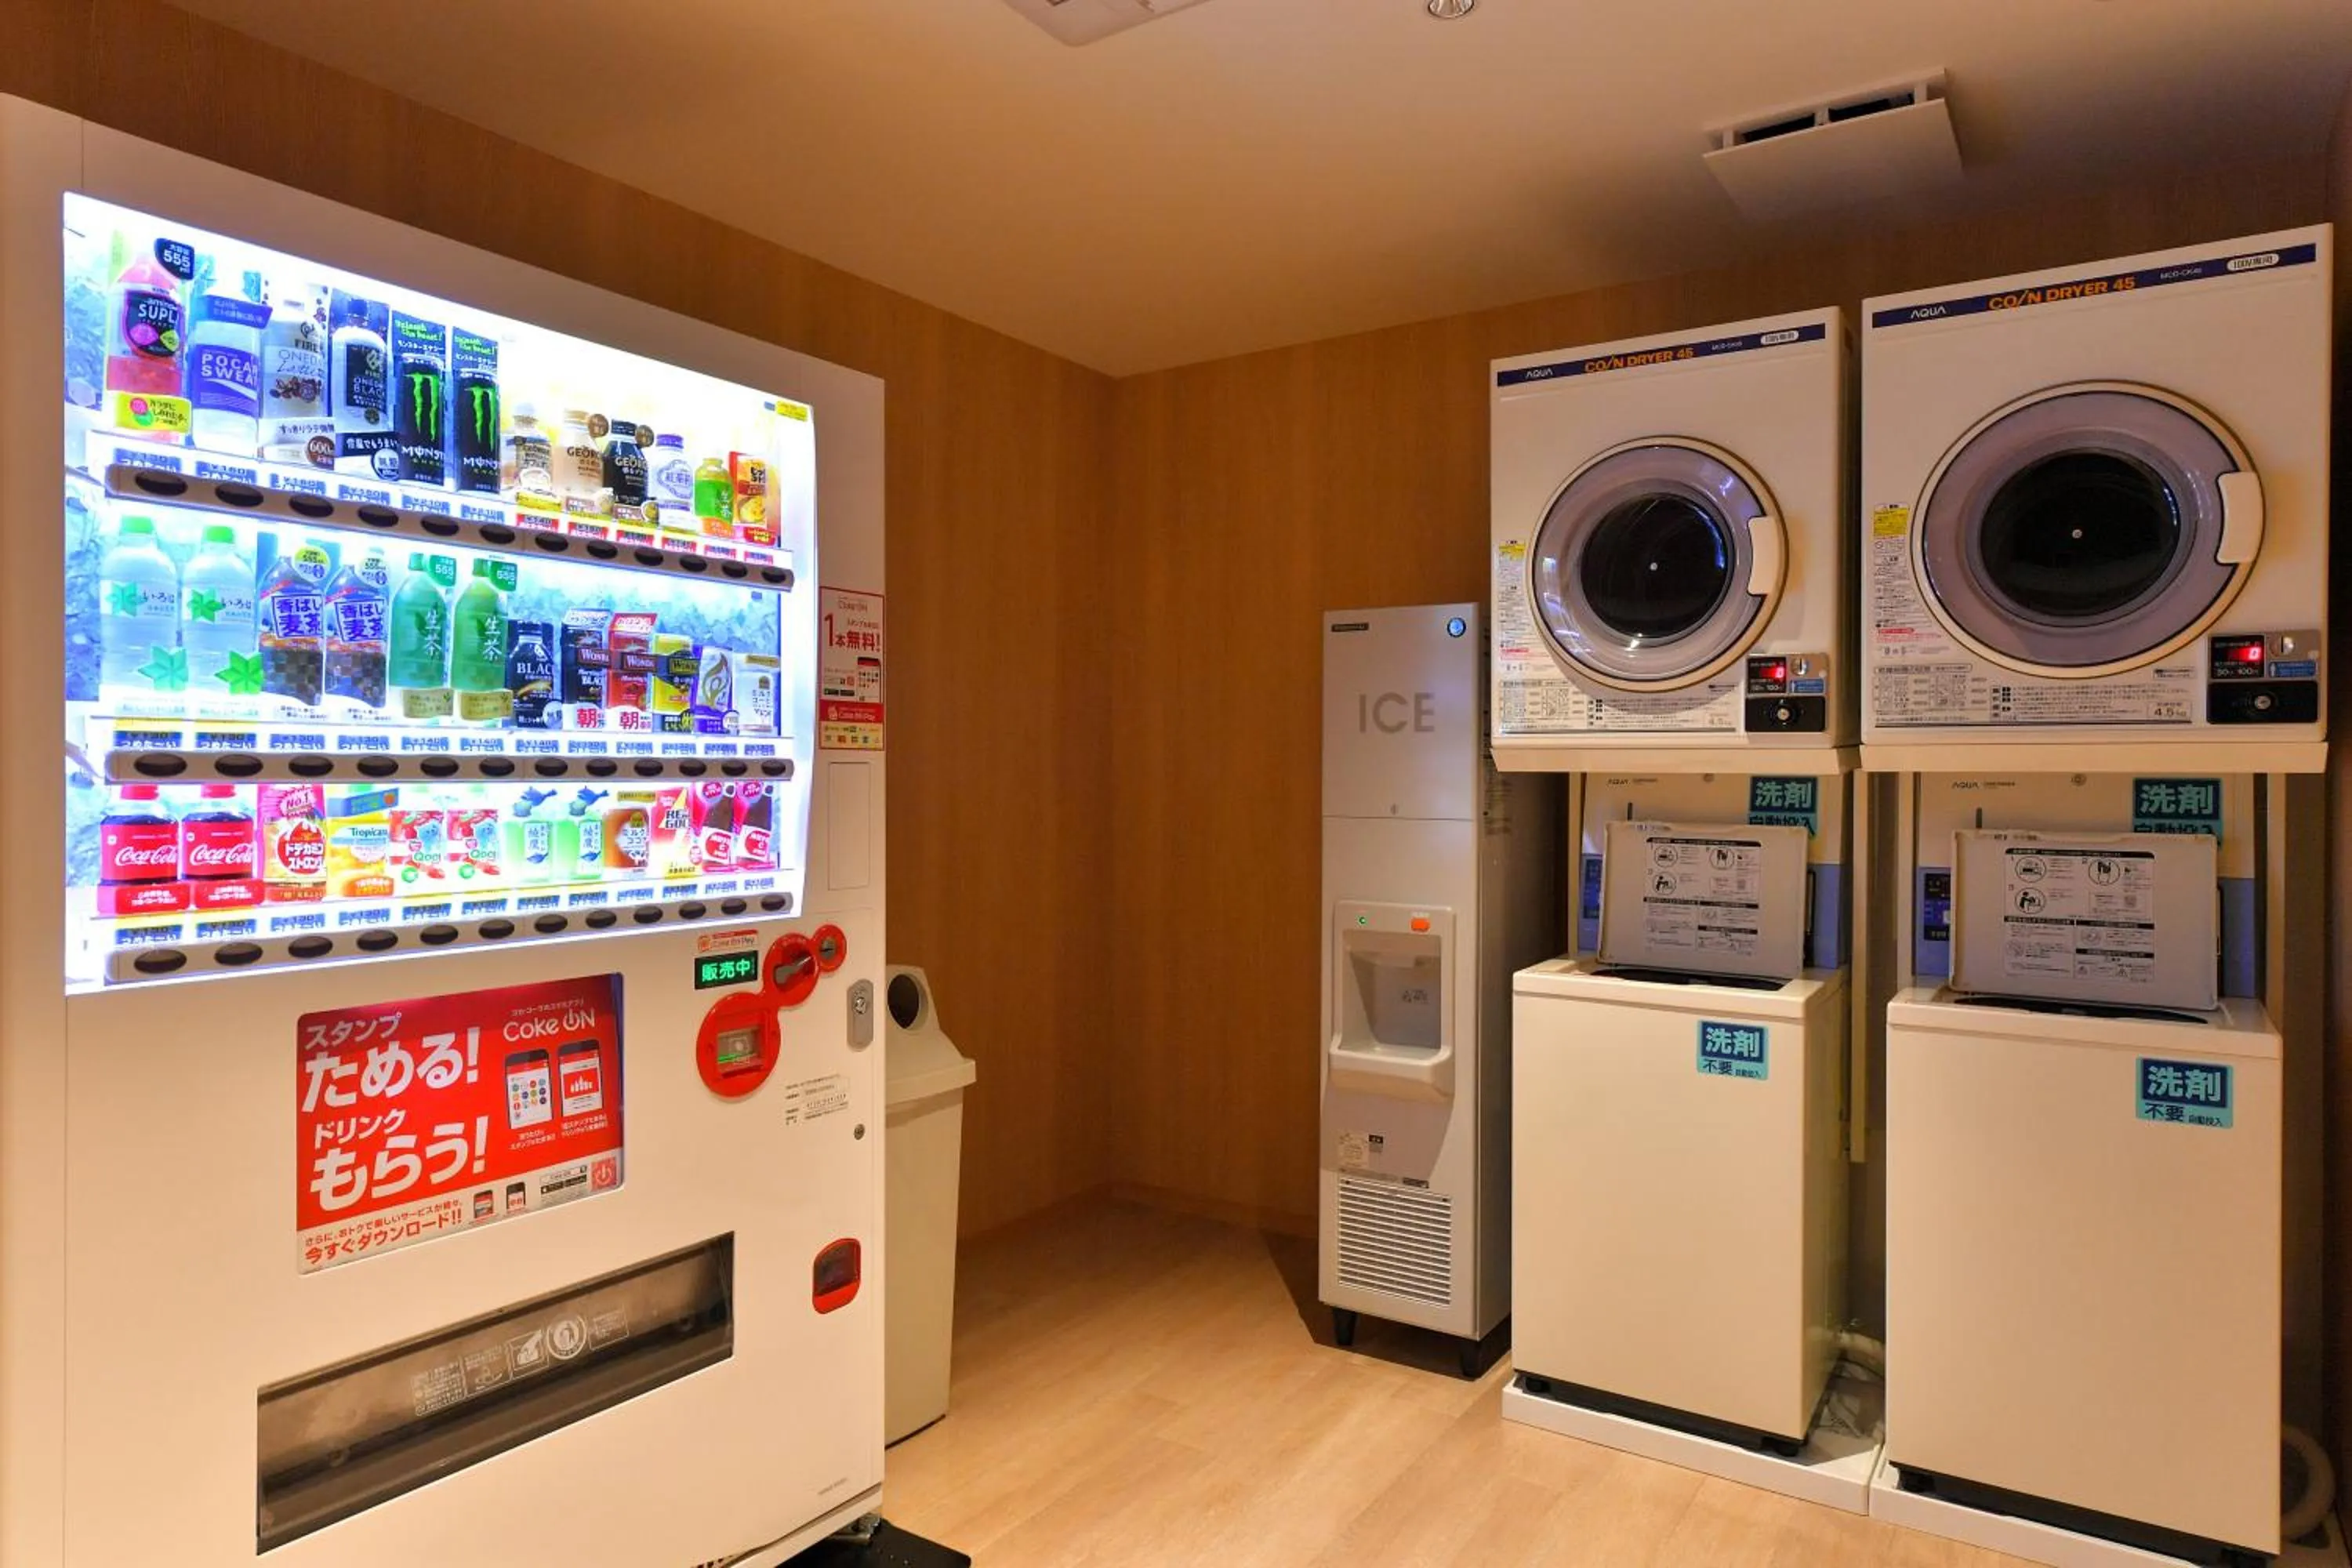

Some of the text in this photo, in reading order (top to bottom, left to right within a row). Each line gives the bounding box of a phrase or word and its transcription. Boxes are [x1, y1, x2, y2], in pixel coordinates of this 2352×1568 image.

[163, 249, 191, 267] 555
[1910, 305, 1947, 319] AQUA
[2045, 281, 2109, 303] DRYER
[2113, 275, 2136, 291] 45
[1627, 350, 1673, 366] DRYER
[424, 608, 443, 659] 生茶
[482, 615, 502, 662] 生茶
[1359, 691, 1435, 734] ICE
[1755, 781, 1813, 808] 洗剤
[2140, 784, 2215, 815] 洗剤
[702, 958, 750, 982] 販売中
[305, 1011, 402, 1051] スタンプ
[503, 1017, 560, 1042] Coke
[1705, 1026, 1760, 1058] 洗剤
[301, 1026, 481, 1112] ためる!
[1702, 1058, 1733, 1075] 不要
[2147, 1065, 2222, 1102] 洗剤
[314, 1108, 406, 1150] ドリンク
[2144, 1102, 2184, 1122] 不要
[310, 1116, 489, 1211] もらう!
[305, 1208, 462, 1265] 今すぐダウンロード!!
